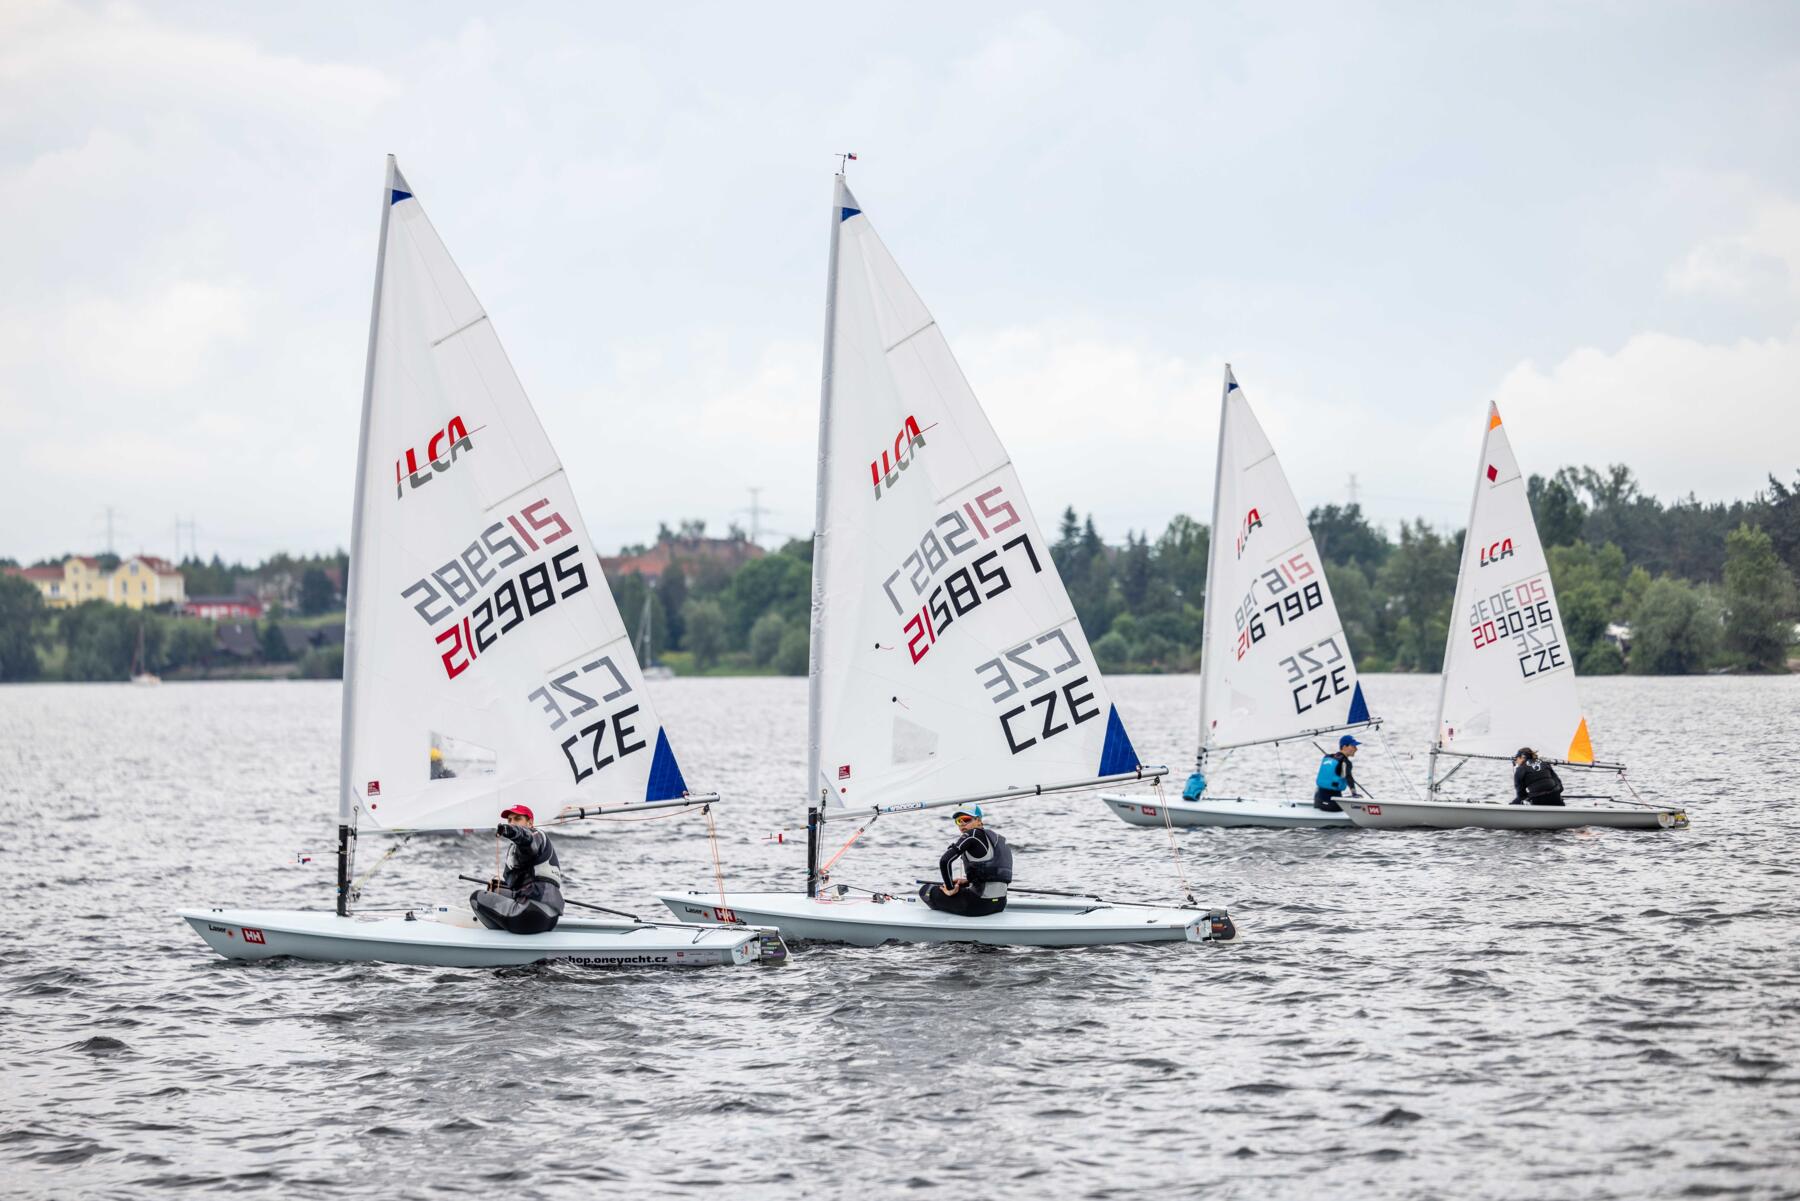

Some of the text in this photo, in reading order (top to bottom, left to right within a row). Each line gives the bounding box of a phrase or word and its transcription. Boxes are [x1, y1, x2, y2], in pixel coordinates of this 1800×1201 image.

[396, 416, 473, 500] ILCA
[871, 415, 926, 501] ILCA
[435, 544, 589, 680] 212985
[903, 533, 1042, 665] 215857
[1238, 581, 1323, 662] 216798
[1471, 600, 1553, 649] 203036
[1292, 665, 1350, 715] CZE
[1520, 644, 1565, 678] CZE
[560, 703, 647, 784] CZE
[999, 675, 1100, 755] CZE
